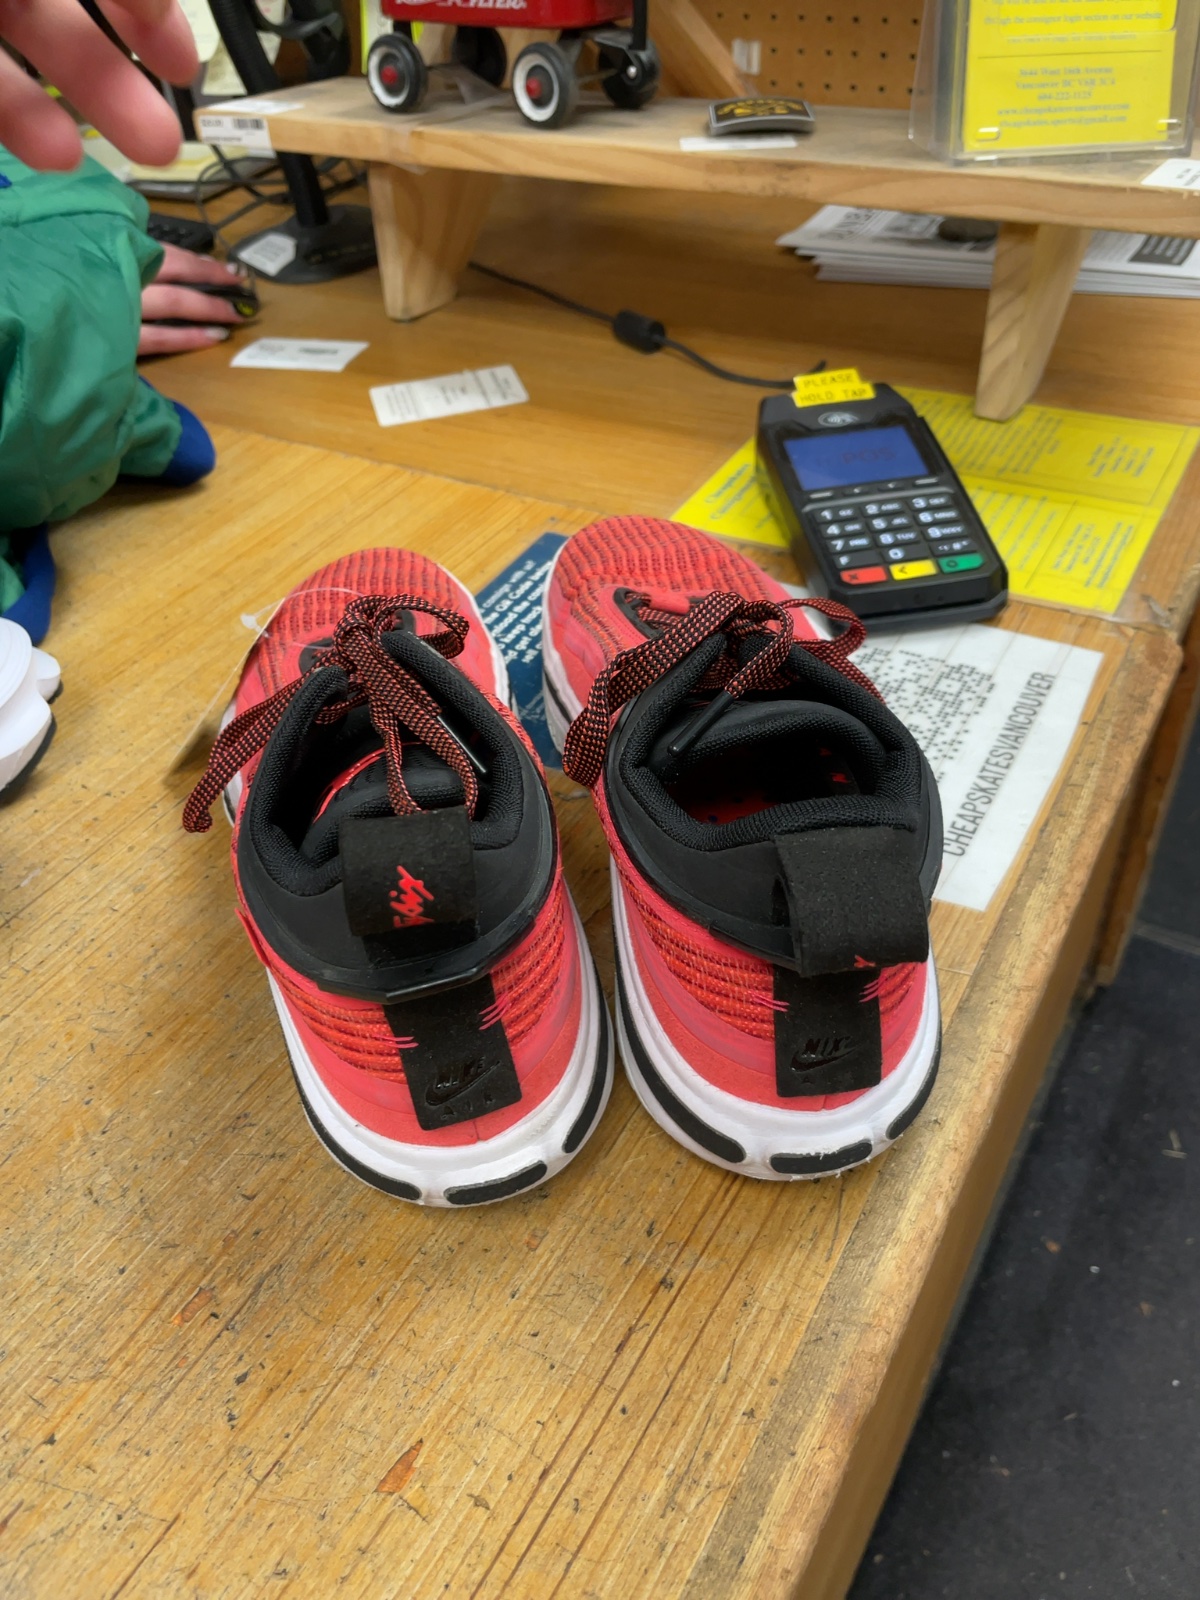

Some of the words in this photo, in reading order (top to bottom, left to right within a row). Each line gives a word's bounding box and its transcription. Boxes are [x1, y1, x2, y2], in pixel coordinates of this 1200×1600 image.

[803, 373, 854, 388] PLEASE
[842, 387, 868, 399] TAP
[821, 508, 833, 520] 1
[865, 503, 880, 515] 2
[872, 517, 887, 529] 5
[826, 524, 841, 536] 4
[831, 538, 845, 551] 7
[495, 599, 514, 612] QR
[508, 580, 534, 600] Code
[499, 623, 526, 644] keep
[943, 671, 1056, 857] CHEAPSKATESVANCOUVER
